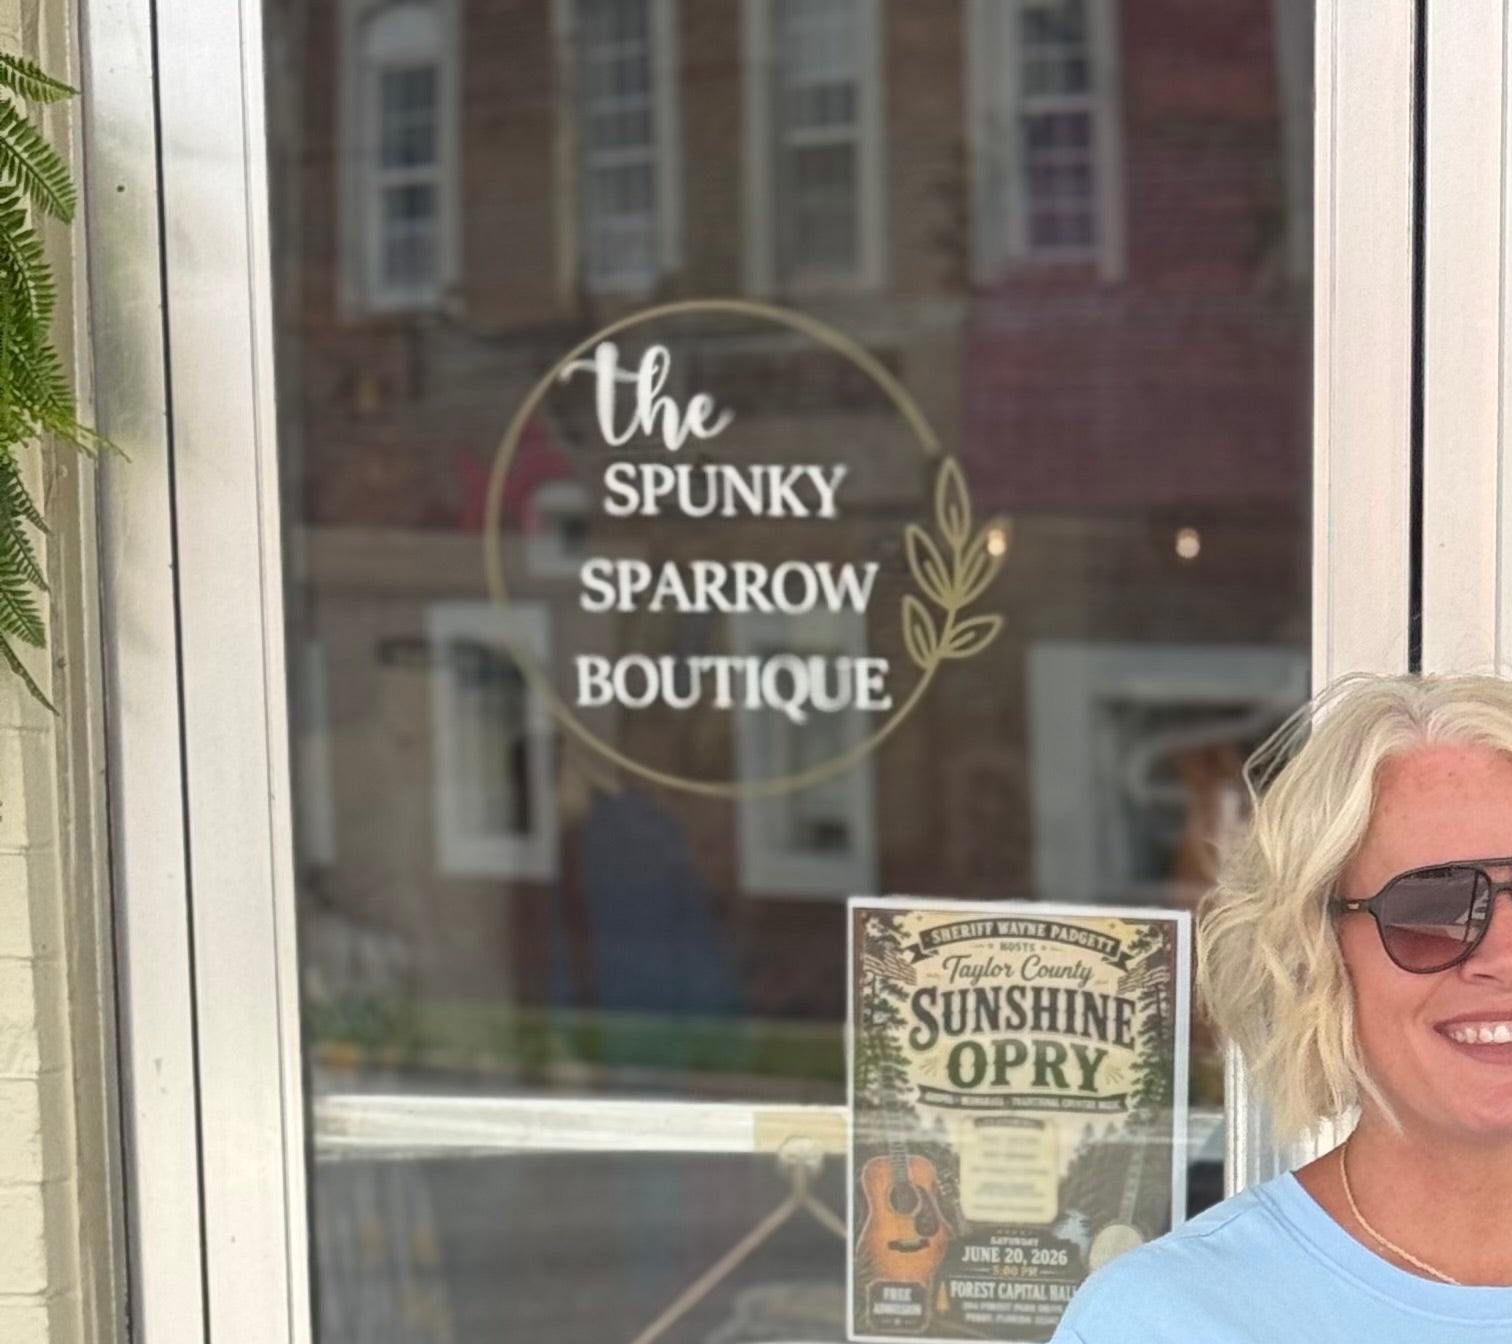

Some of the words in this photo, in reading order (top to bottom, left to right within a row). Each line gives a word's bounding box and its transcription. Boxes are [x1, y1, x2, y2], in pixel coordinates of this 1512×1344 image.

[559, 341, 735, 451] the
[603, 462, 848, 518] SPUNKY
[579, 558, 879, 614] SPARROW
[575, 654, 893, 725] BOUTIQUE
[930, 921, 994, 944] SHERIFF
[997, 920, 1047, 937] WAYNE
[1050, 926, 1115, 953] PADGETT
[942, 954, 1014, 986] Taylor
[1020, 954, 1095, 988] County
[908, 985, 1136, 1052] SUNSHINE
[947, 1038, 1108, 1092] OPRY
[961, 1246, 1000, 1263] JUNE
[1004, 1248, 1028, 1265] 20,
[1031, 1249, 1069, 1266] 2026
[950, 1280, 996, 1299] FOREST
[998, 1282, 1048, 1301] CAPITAL
